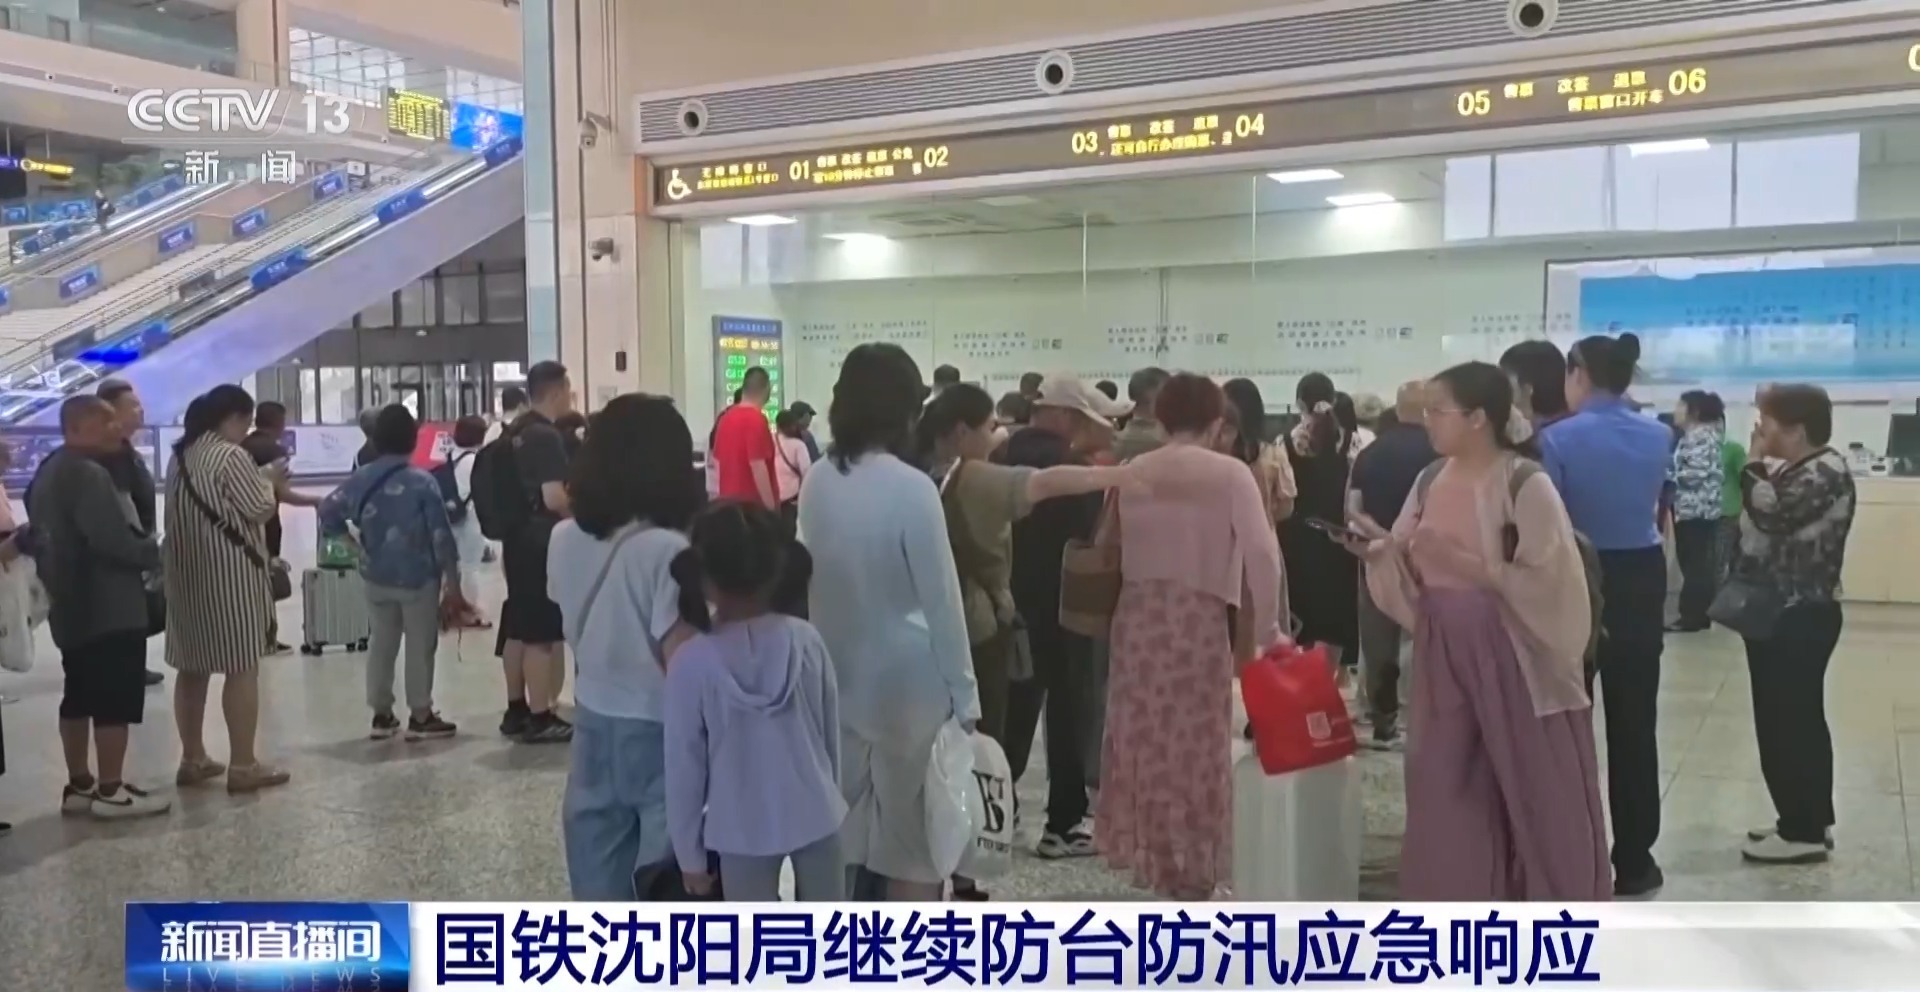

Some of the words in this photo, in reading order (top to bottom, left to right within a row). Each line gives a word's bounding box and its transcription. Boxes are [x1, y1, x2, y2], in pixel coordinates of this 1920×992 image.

[1557, 76, 1590, 94] 改签
[1668, 67, 1707, 95] 06
[1457, 90, 1491, 116] 05
[1235, 113, 1265, 137] 04
[1071, 131, 1098, 154] 03
[924, 145, 949, 168] 02
[789, 160, 810, 180] 01
